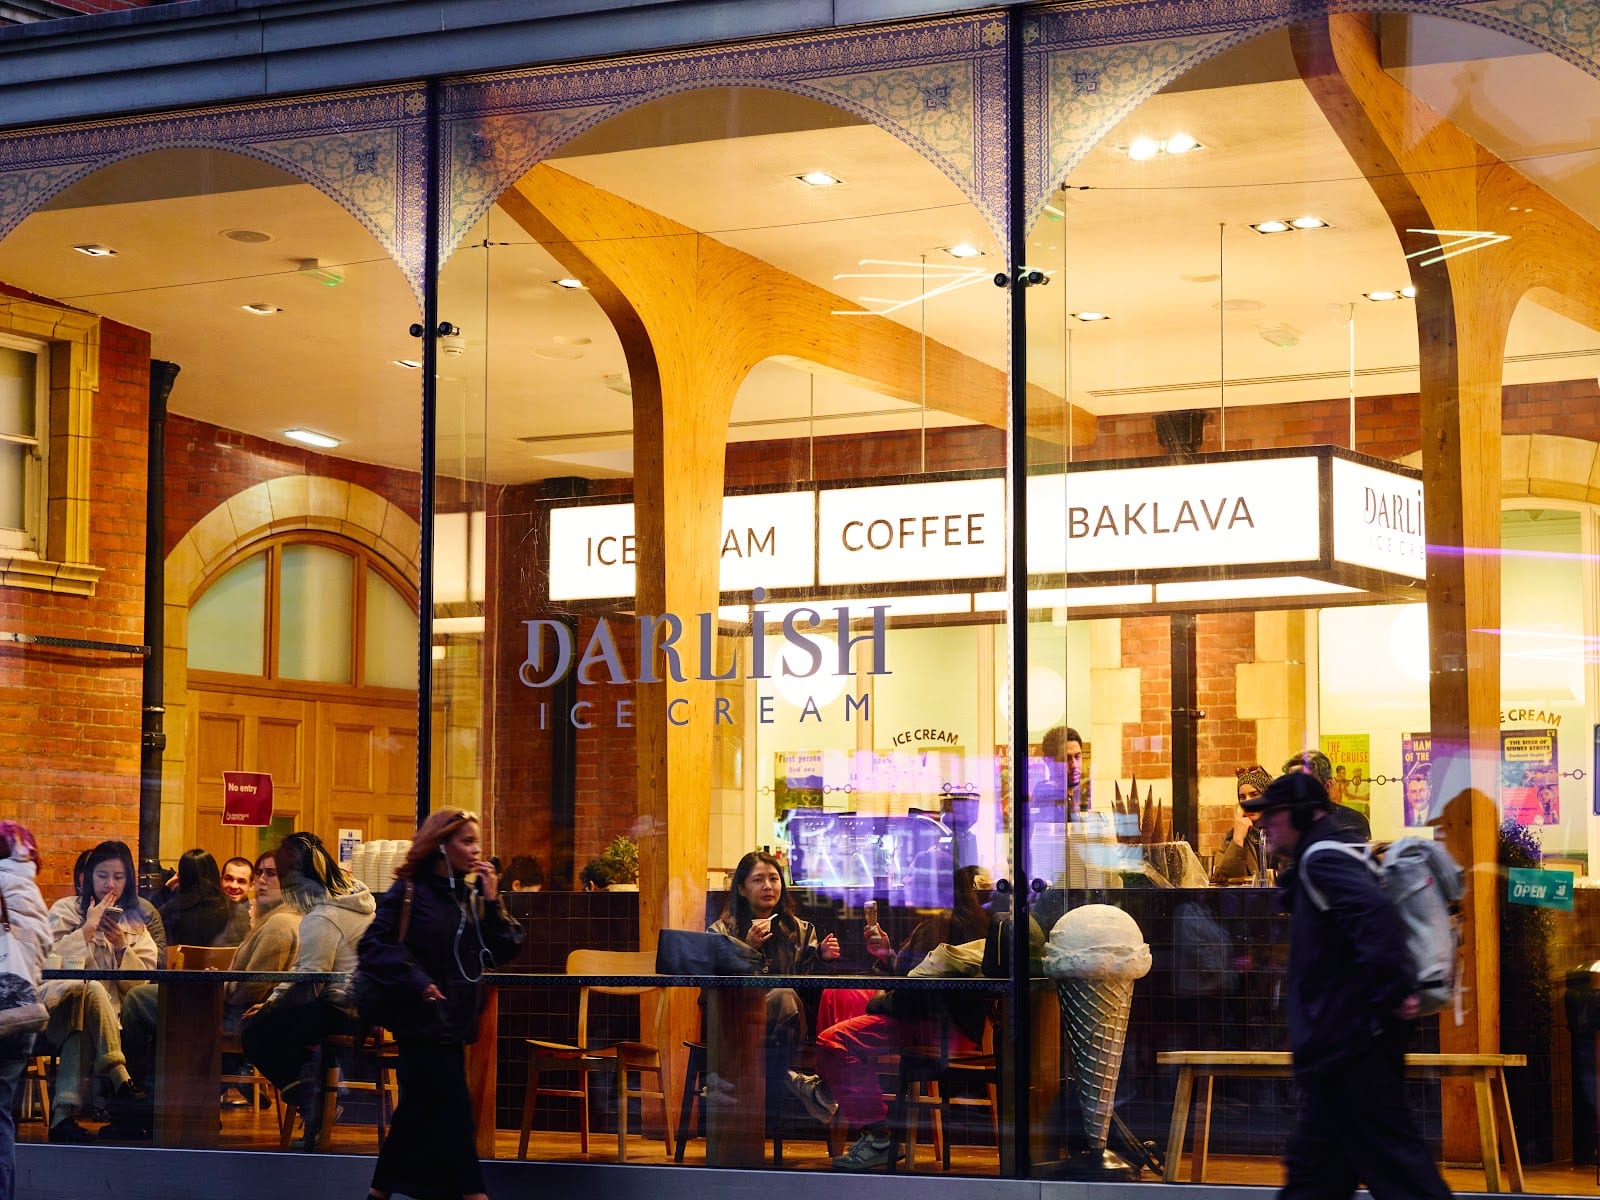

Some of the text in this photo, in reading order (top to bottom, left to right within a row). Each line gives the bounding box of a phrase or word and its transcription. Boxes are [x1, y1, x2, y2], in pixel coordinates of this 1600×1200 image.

[1068, 496, 1255, 539] BAKLAVA
[1364, 486, 1422, 537] DARLi
[841, 513, 985, 552] COFFEE
[587, 535, 636, 566] ICE
[540, 694, 870, 730] ICE CREAM
[1508, 709, 1562, 727] CREAM
[892, 729, 959, 747] ICE CREAM
[1327, 741, 1341, 753] THE
[1413, 740, 1432, 752] HAM
[1325, 752, 1369, 763] ST CRUISE
[1405, 752, 1430, 762] OF THE
[228, 782, 257, 795] No entry
[1513, 884, 1547, 899] OPEN
